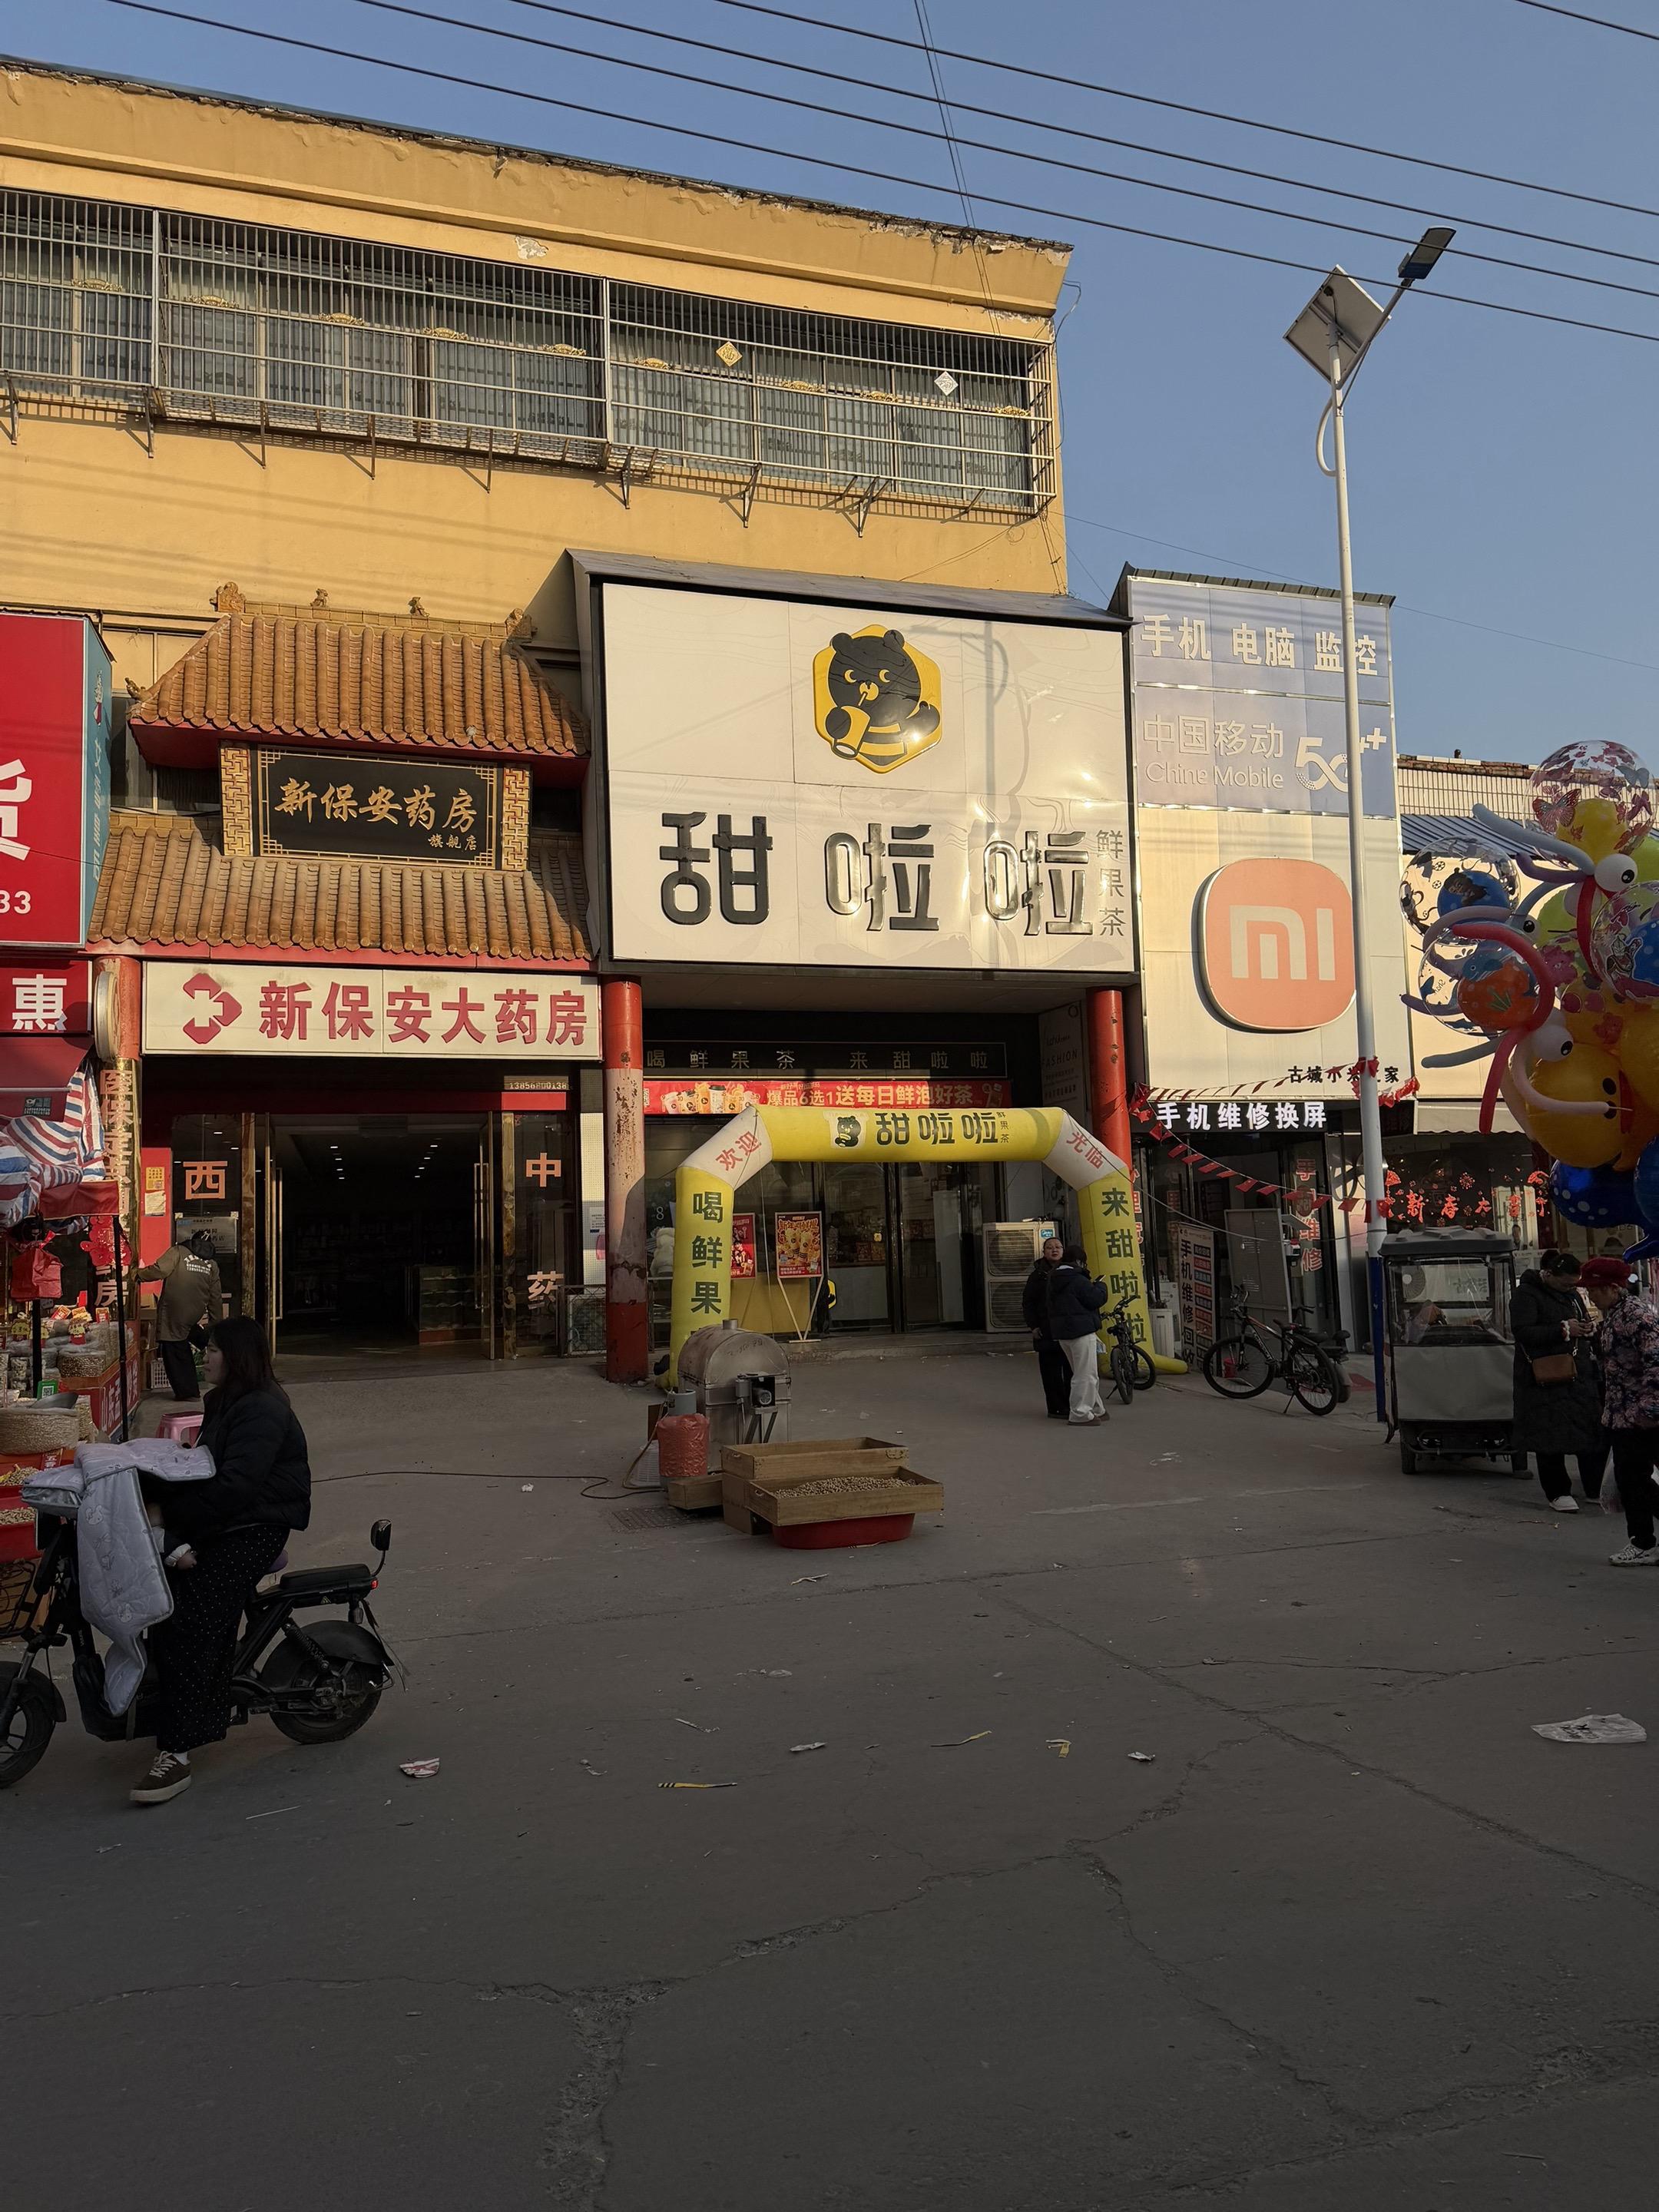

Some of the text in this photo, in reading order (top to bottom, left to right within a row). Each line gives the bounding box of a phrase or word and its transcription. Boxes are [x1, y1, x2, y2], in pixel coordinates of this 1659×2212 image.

[1141, 614, 1378, 676] 手机 电脑 监控
[1143, 714, 1285, 759] 中国移动
[1213, 765, 1284, 790] Mobile
[274, 776, 478, 833] 新保安药房
[427, 833, 478, 852] 旗舰店
[659, 811, 1093, 937] 甜啦啦
[1096, 829, 1126, 938] 鲜果茶
[12, 974, 68, 1031] 惠
[259, 980, 587, 1046] 新保安大药房
[647, 1049, 988, 1069] 喝鲜果茶 来甜啦啦
[876, 1111, 998, 1146] 甜啦啦
[1157, 1101, 1327, 1131] 手机维修换屏
[715, 1131, 763, 1172] 欢迎
[1065, 1130, 1104, 1170] 光临
[182, 1160, 228, 1200] 西
[691, 1191, 724, 1316] 喝鲜果
